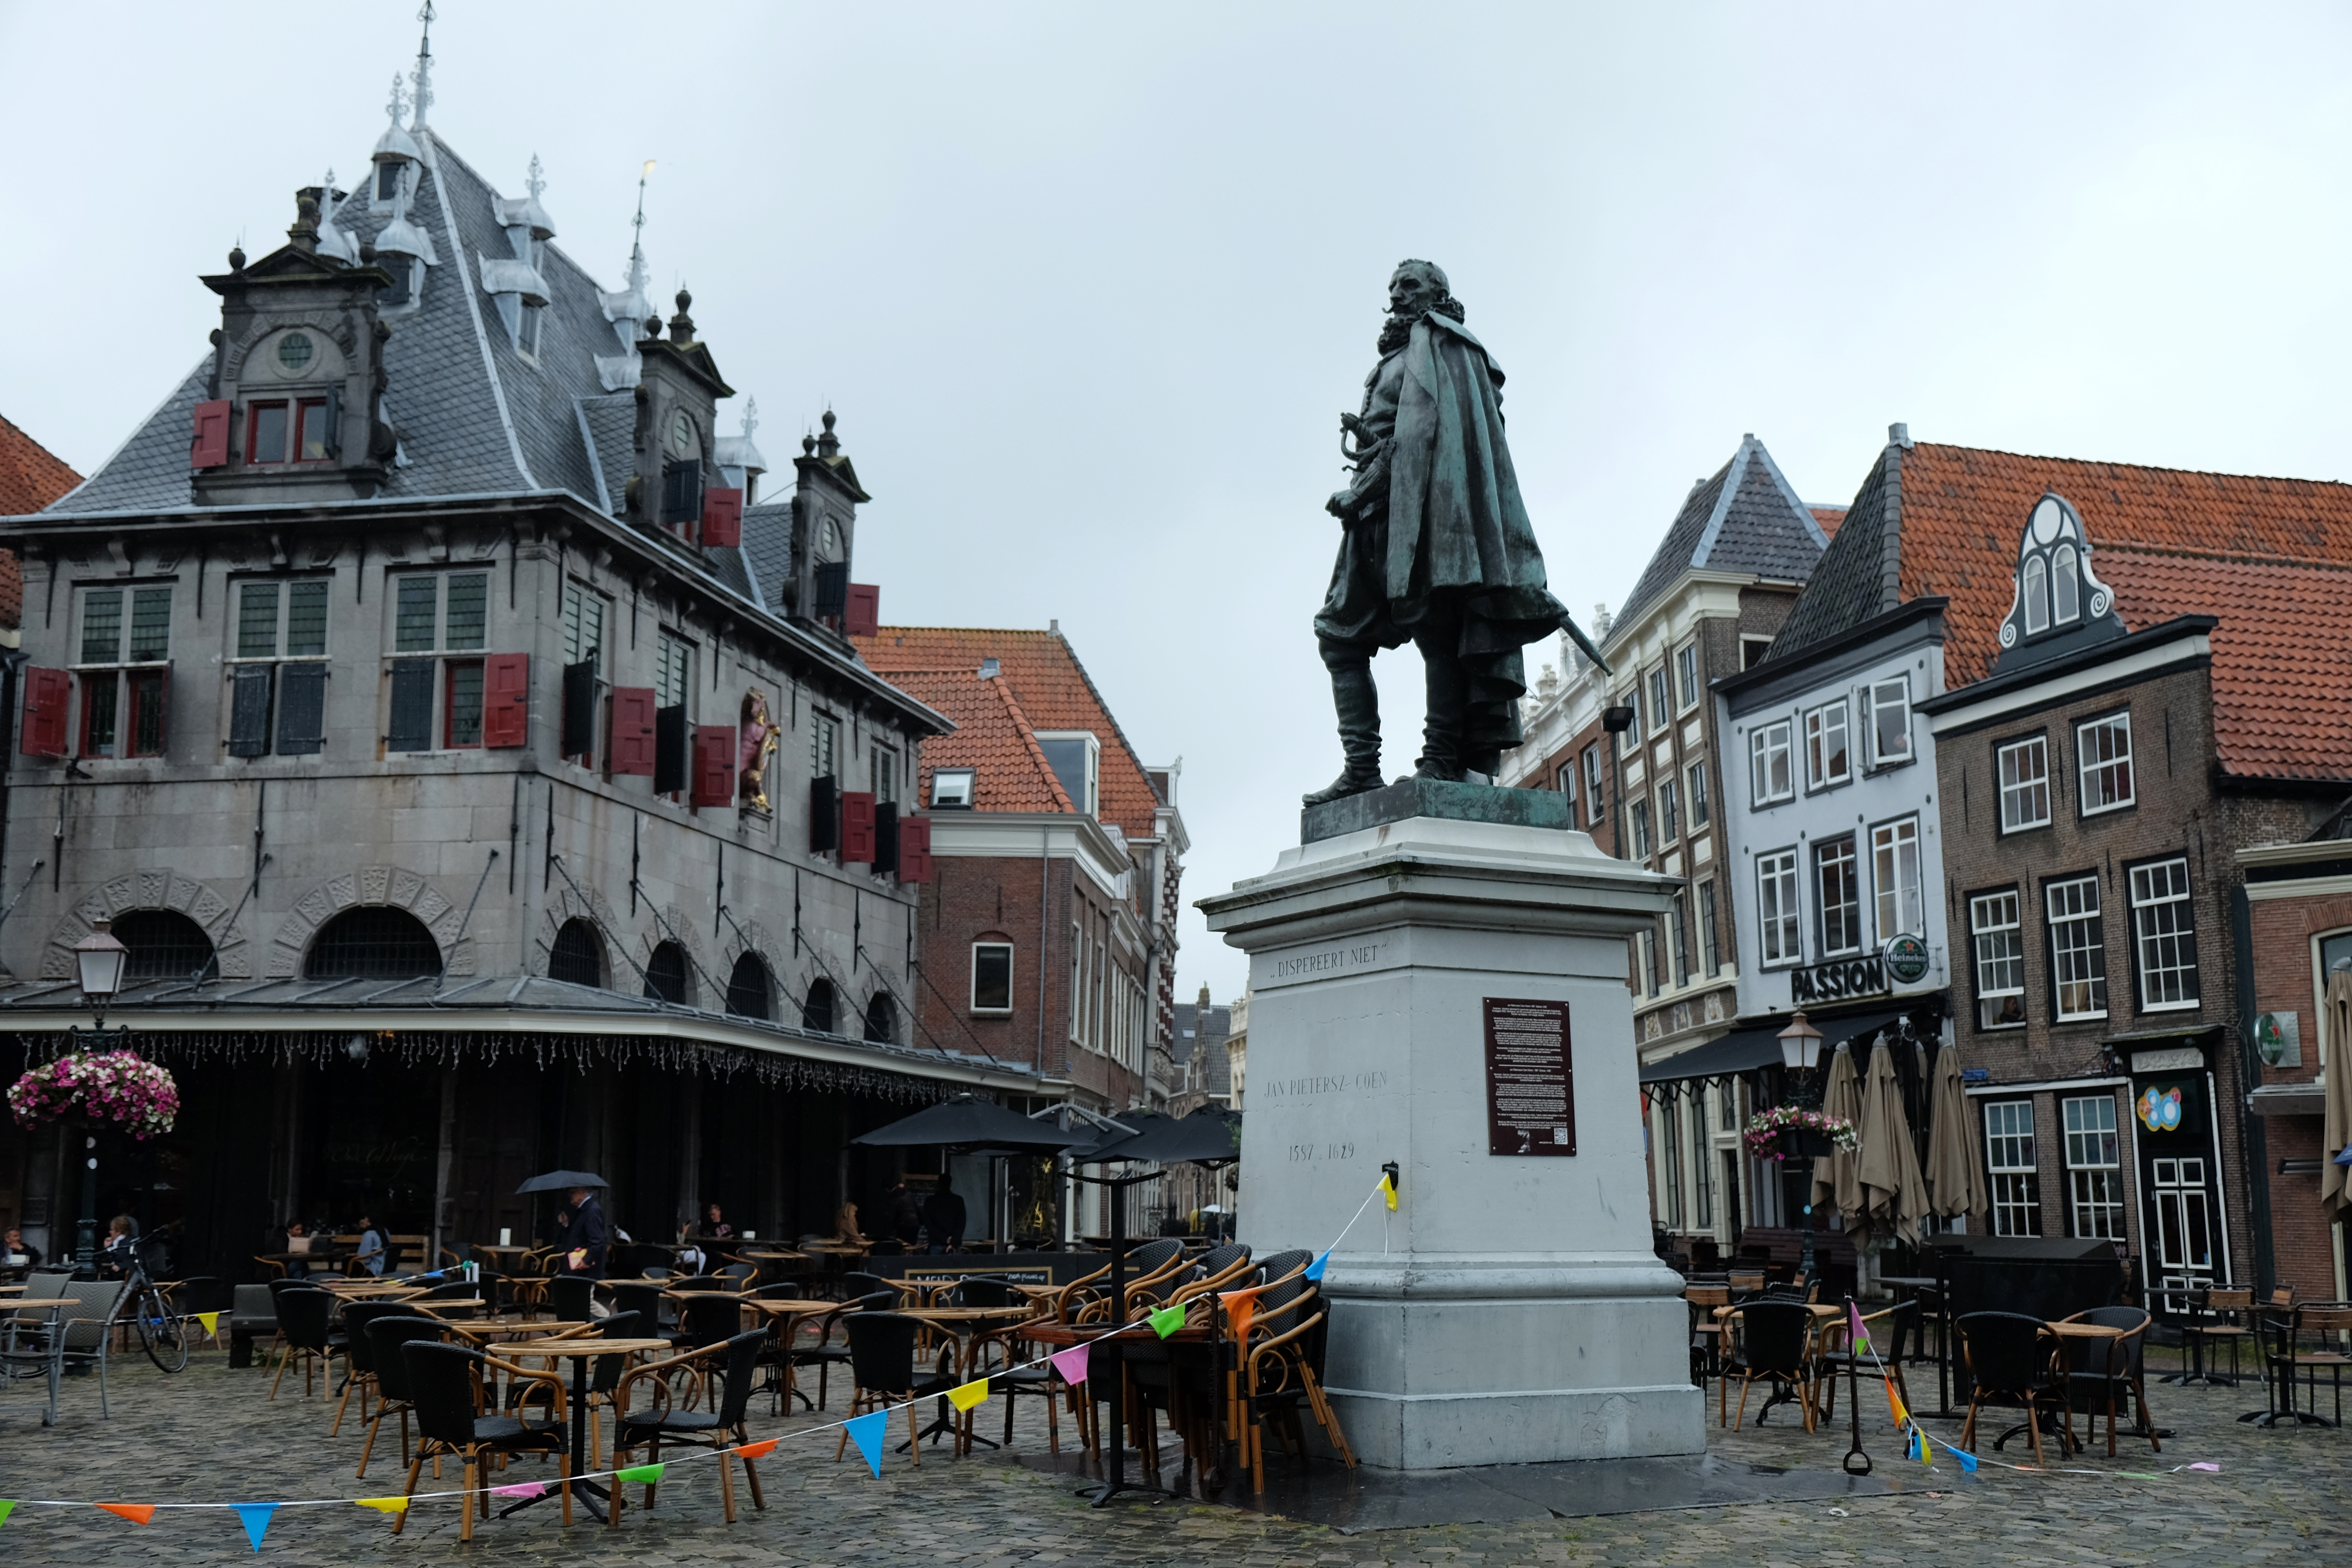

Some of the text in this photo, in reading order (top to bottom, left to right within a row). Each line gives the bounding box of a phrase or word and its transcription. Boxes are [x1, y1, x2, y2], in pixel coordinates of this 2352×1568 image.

[1791, 958, 1884, 1003] PASSION
[1264, 1081, 1285, 1098] JAN
[1356, 1071, 1387, 1090] COEN
[1289, 1144, 1314, 1161] 1587
[1328, 1142, 1354, 1159] 1629
